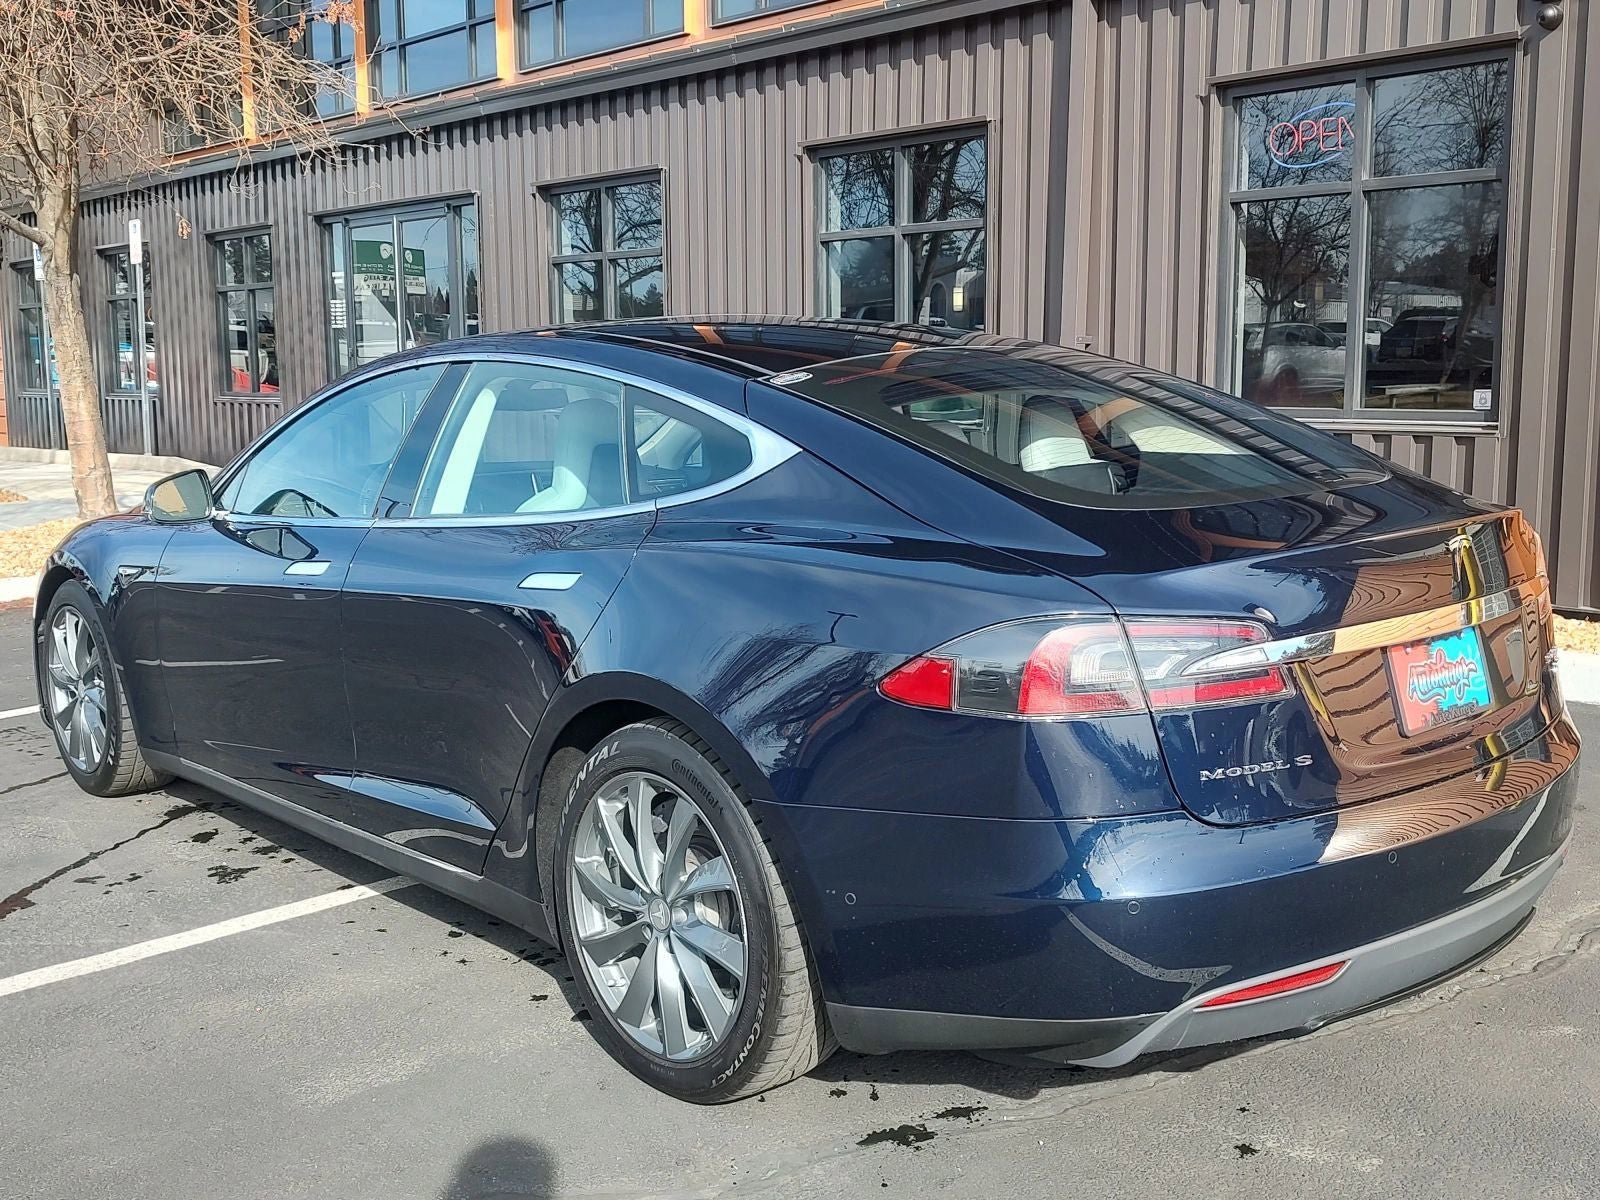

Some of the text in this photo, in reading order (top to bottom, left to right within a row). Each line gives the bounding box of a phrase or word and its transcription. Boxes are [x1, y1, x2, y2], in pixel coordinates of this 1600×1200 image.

[1269, 116, 1355, 156] OPEN
[671, 758, 720, 809] Continental
[1199, 754, 1313, 781] MODEL S
